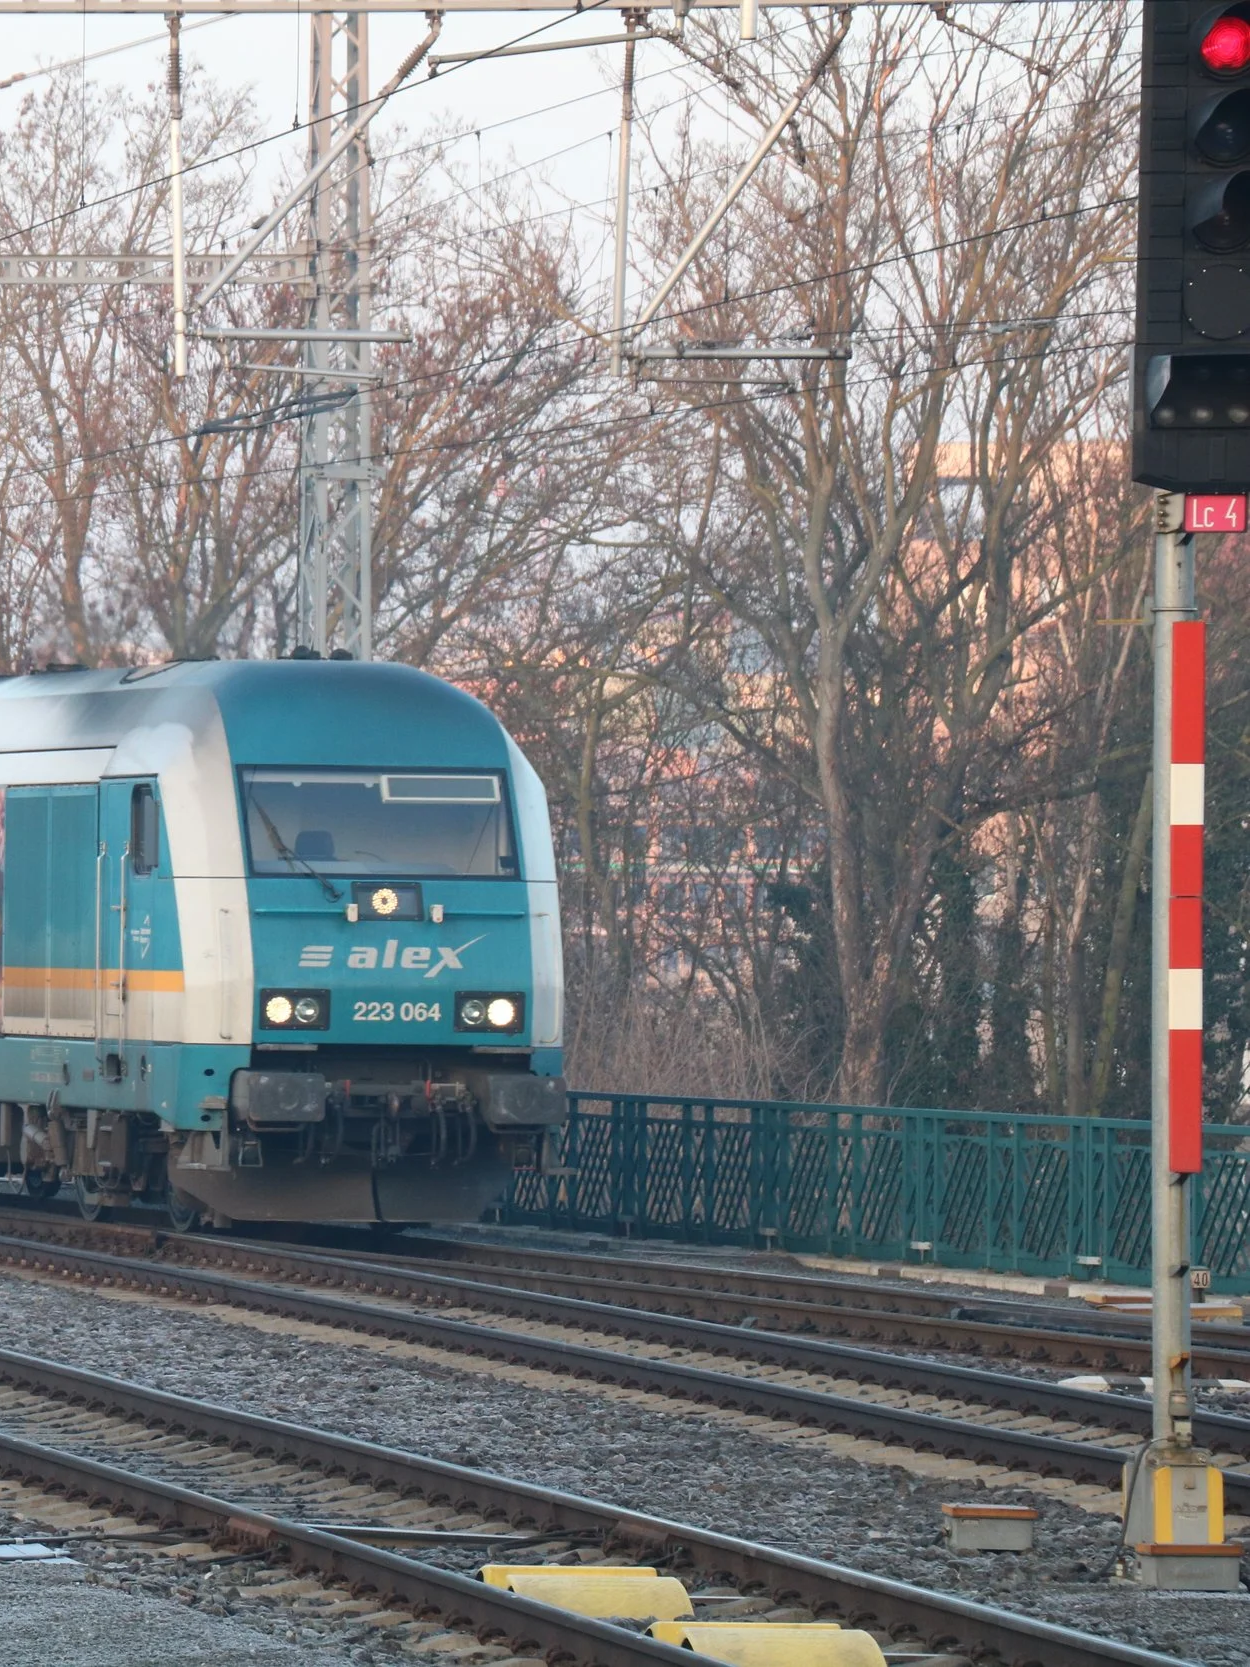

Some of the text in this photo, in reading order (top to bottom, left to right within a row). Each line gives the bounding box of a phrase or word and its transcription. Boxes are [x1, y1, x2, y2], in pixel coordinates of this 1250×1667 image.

[1193, 498, 1237, 528] Lc 4
[346, 932, 491, 978] alex
[353, 1001, 442, 1023] 223 064
[1193, 1272, 1209, 1287] 40
